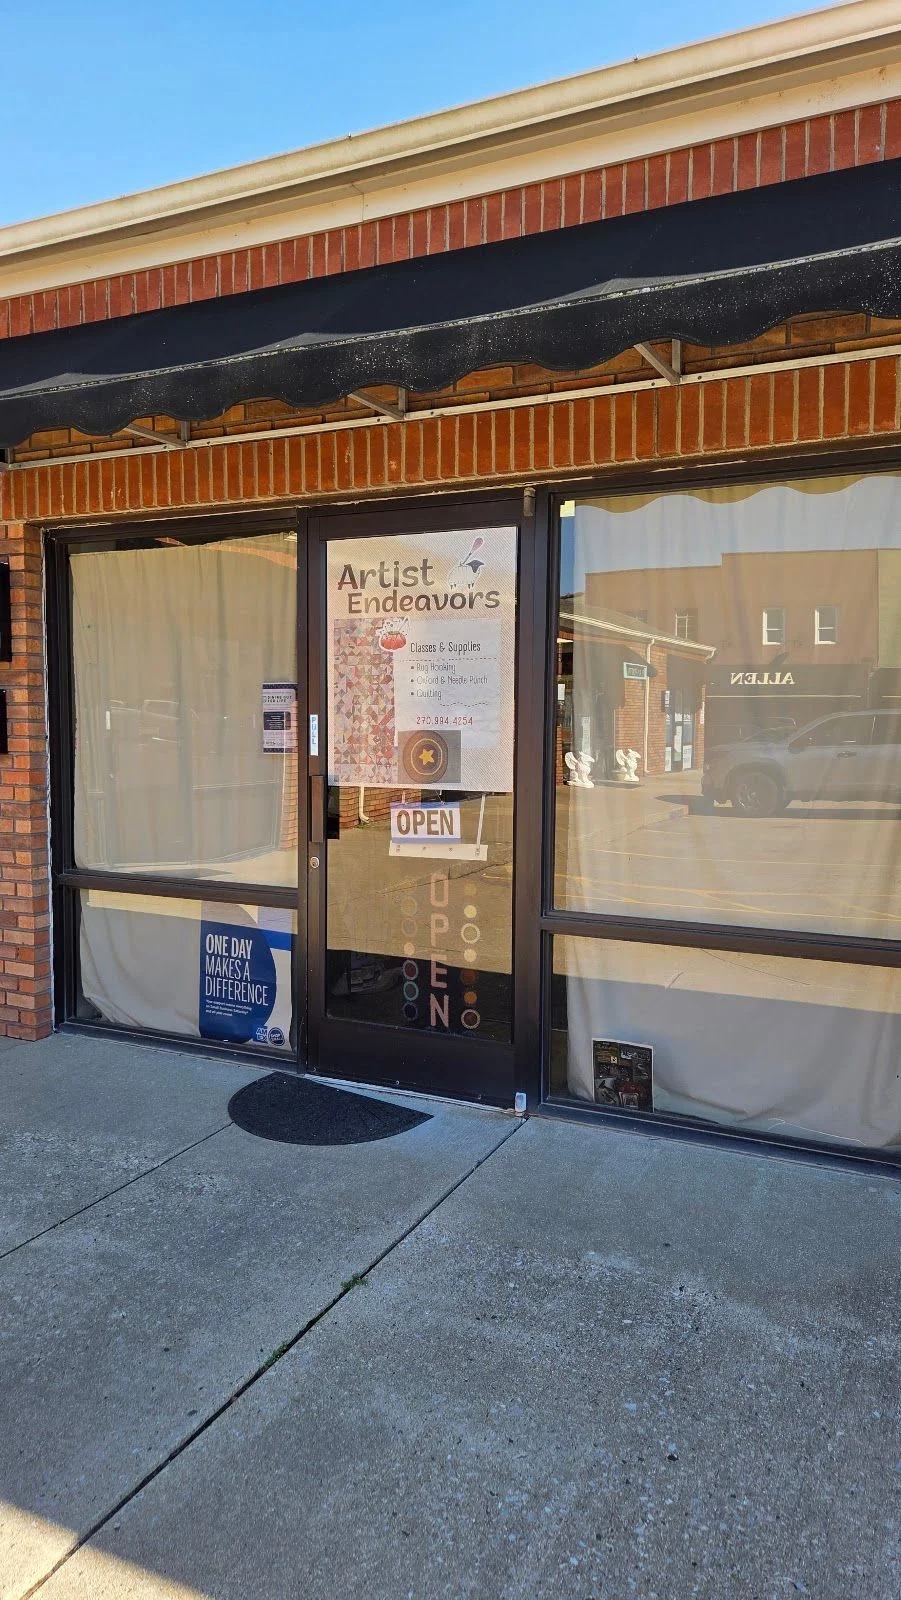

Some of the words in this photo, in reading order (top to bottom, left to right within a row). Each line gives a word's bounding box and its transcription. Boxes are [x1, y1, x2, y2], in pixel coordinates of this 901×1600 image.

[337, 558, 435, 591] Artist
[347, 589, 501, 614] Endeavors
[410, 642, 437, 653] Classes
[439, 641, 445, 652] &
[448, 641, 481, 656] Supplies
[416, 663, 429, 674] Rug
[430, 662, 456, 675] Hooking
[416, 675, 439, 685] Oxford
[440, 675, 446, 685] &
[447, 675, 468, 685] Needle
[469, 674, 488, 685] Punch
[416, 688, 442, 701] Quilting
[416, 716, 473, 726] 270.994.4254
[396, 809, 454, 836] OPEN
[206, 933, 229, 956] ONE
[231, 937, 253, 960] DAY
[429, 872, 450, 1028] OPEN
[205, 955, 242, 980] MAKES
[242, 961, 251, 982] A
[205, 976, 269, 1007] DIFFERENCE
